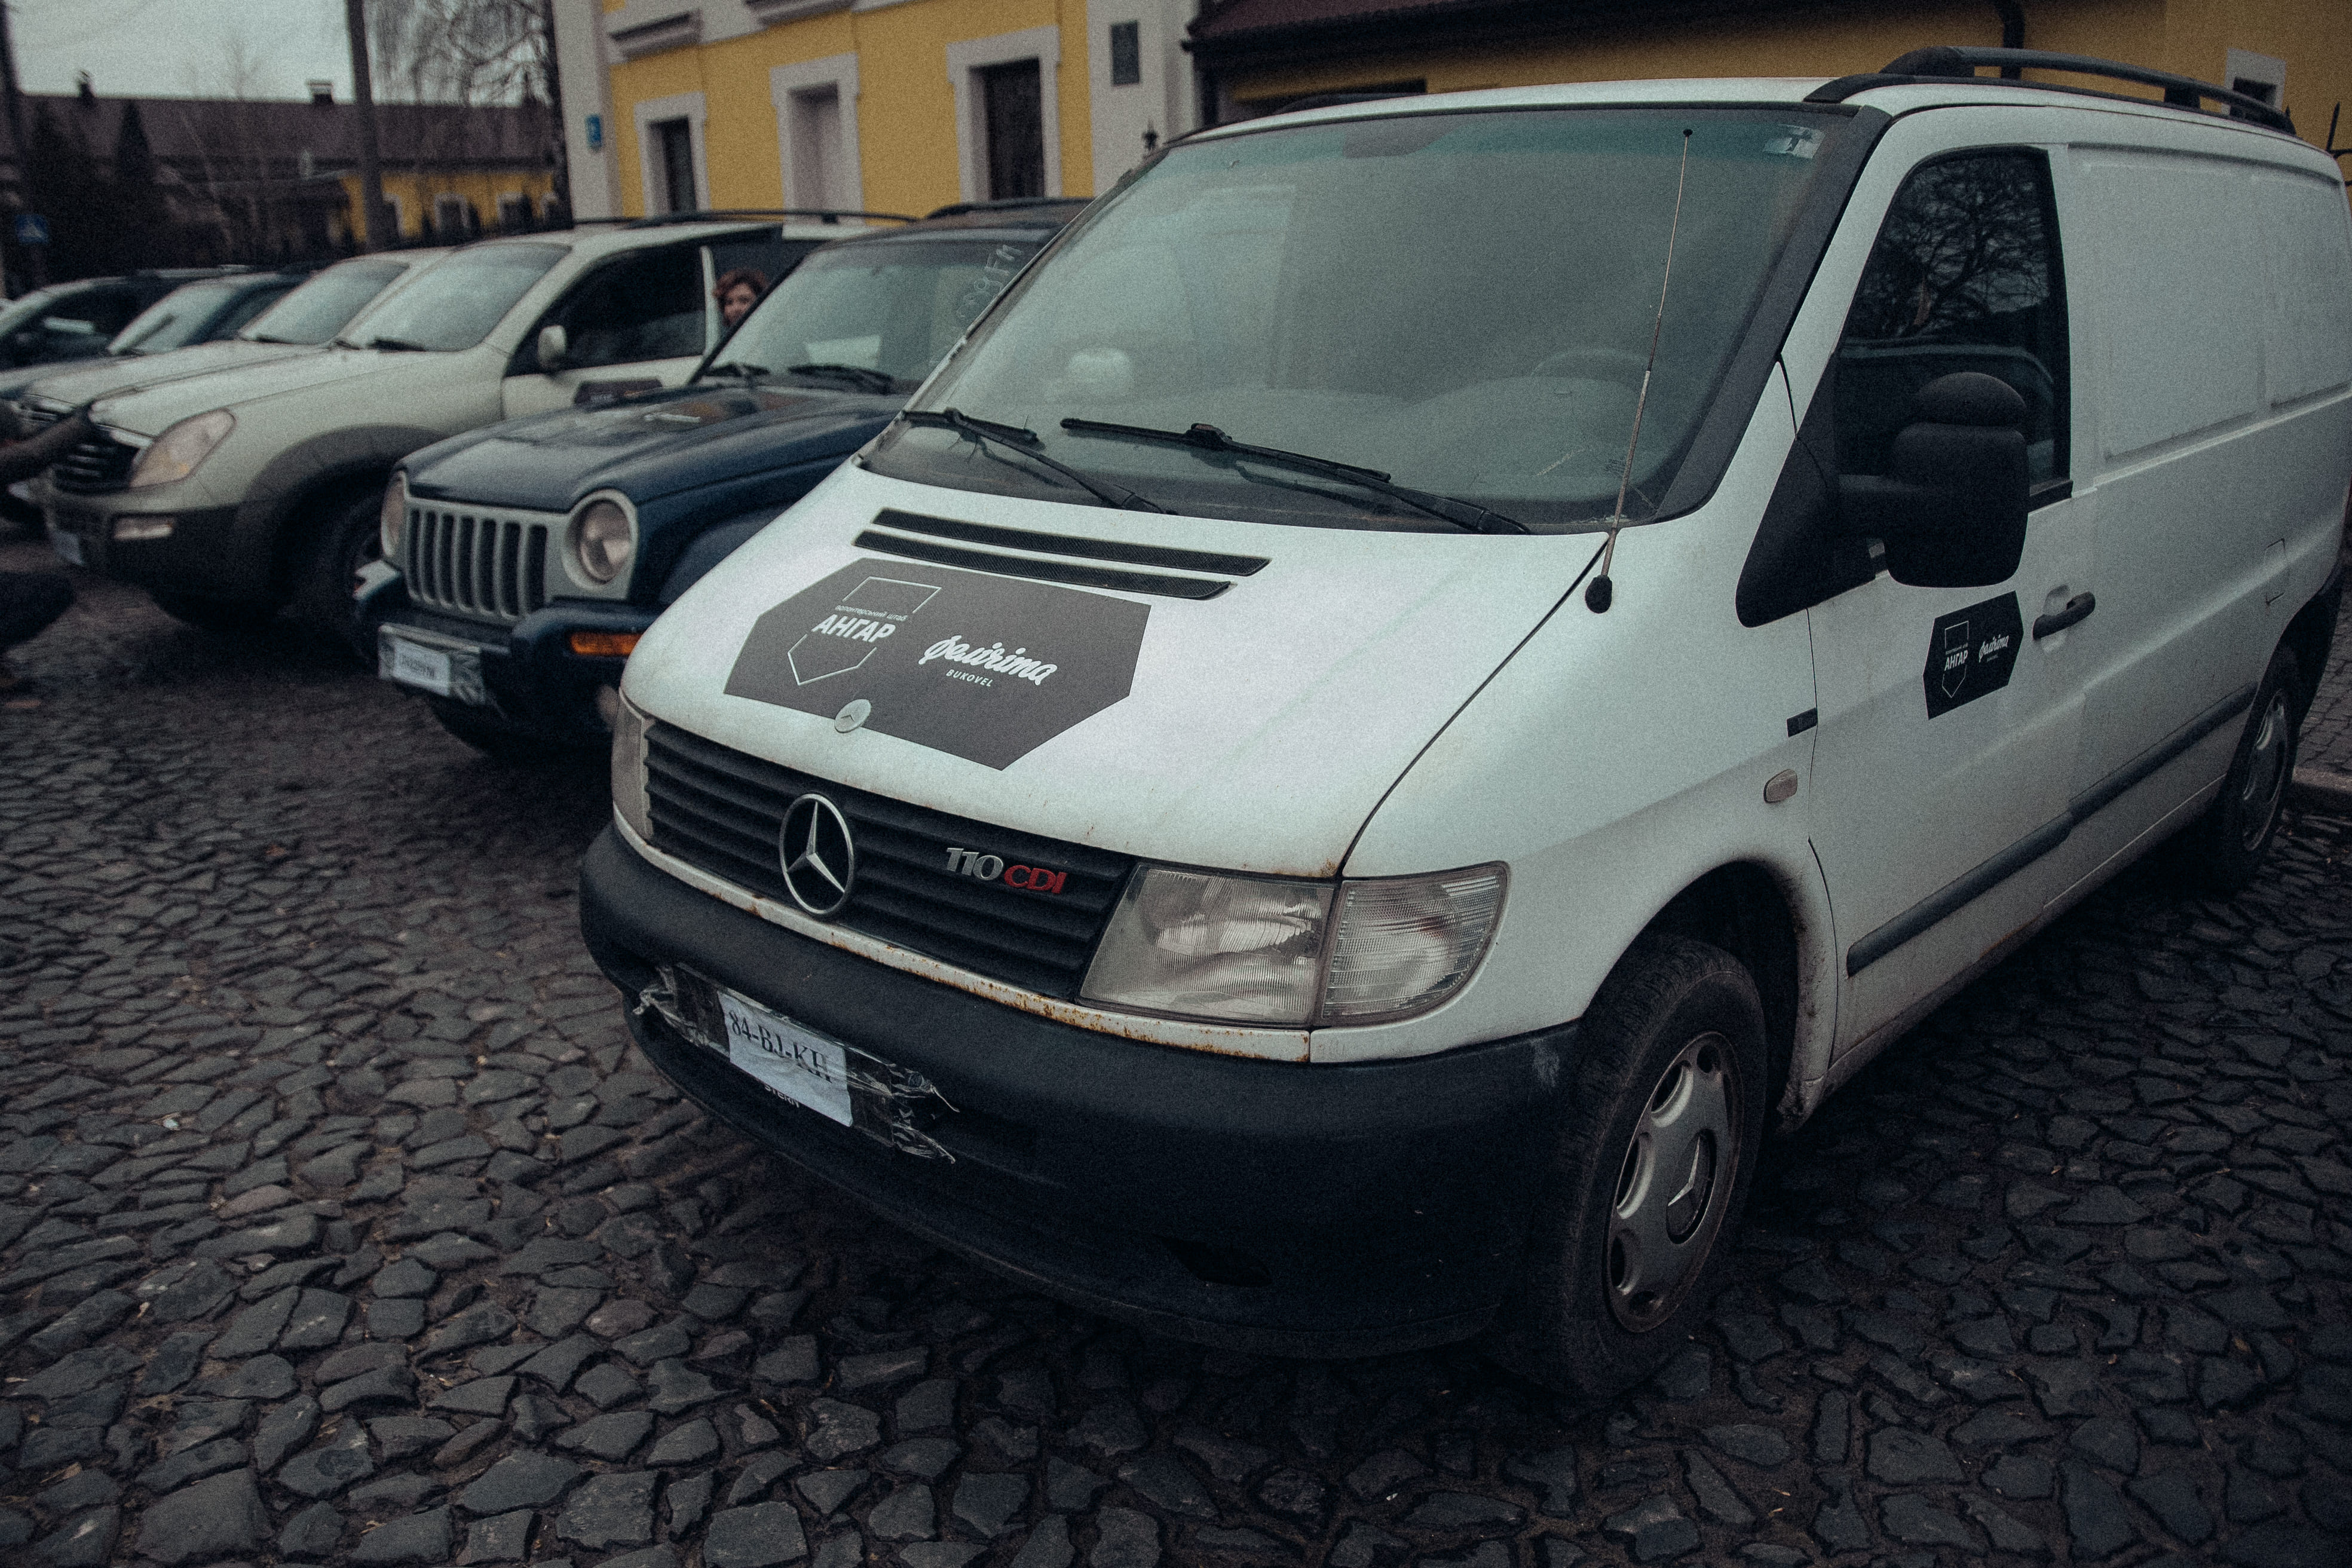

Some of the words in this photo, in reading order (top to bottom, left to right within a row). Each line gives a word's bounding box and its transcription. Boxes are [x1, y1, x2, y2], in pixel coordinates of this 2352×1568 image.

[811, 614, 896, 643] АНГАР
[1944, 650, 1968, 671] АНГАР
[945, 668, 994, 687] BUKOVEL
[946, 847, 1004, 881] 110
[1003, 865, 1068, 894] CDI
